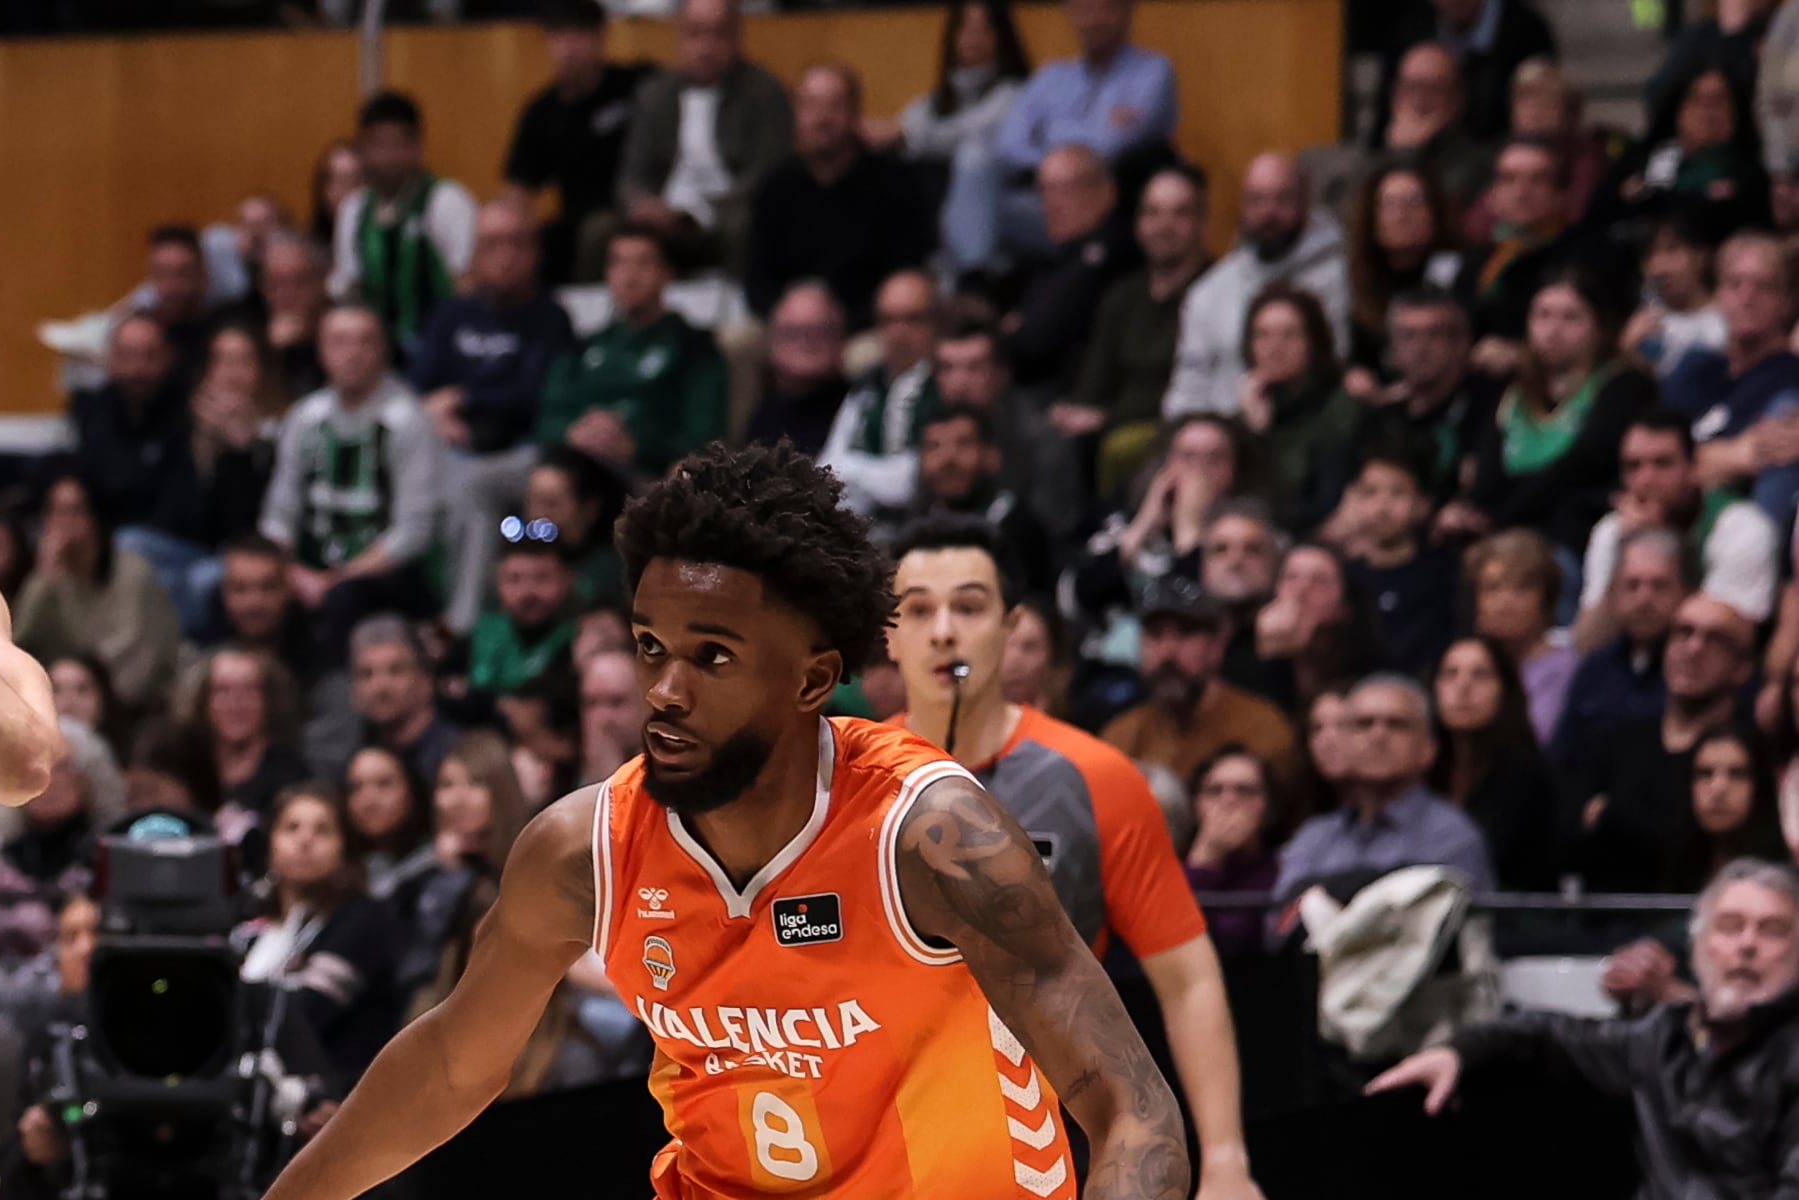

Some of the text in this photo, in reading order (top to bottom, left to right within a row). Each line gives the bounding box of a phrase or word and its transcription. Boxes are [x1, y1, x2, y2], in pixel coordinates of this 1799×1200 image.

[779, 913, 807, 928] liga
[781, 924, 838, 940] endesa
[636, 995, 882, 1054] VALENCIA
[752, 1091, 819, 1182] 8
